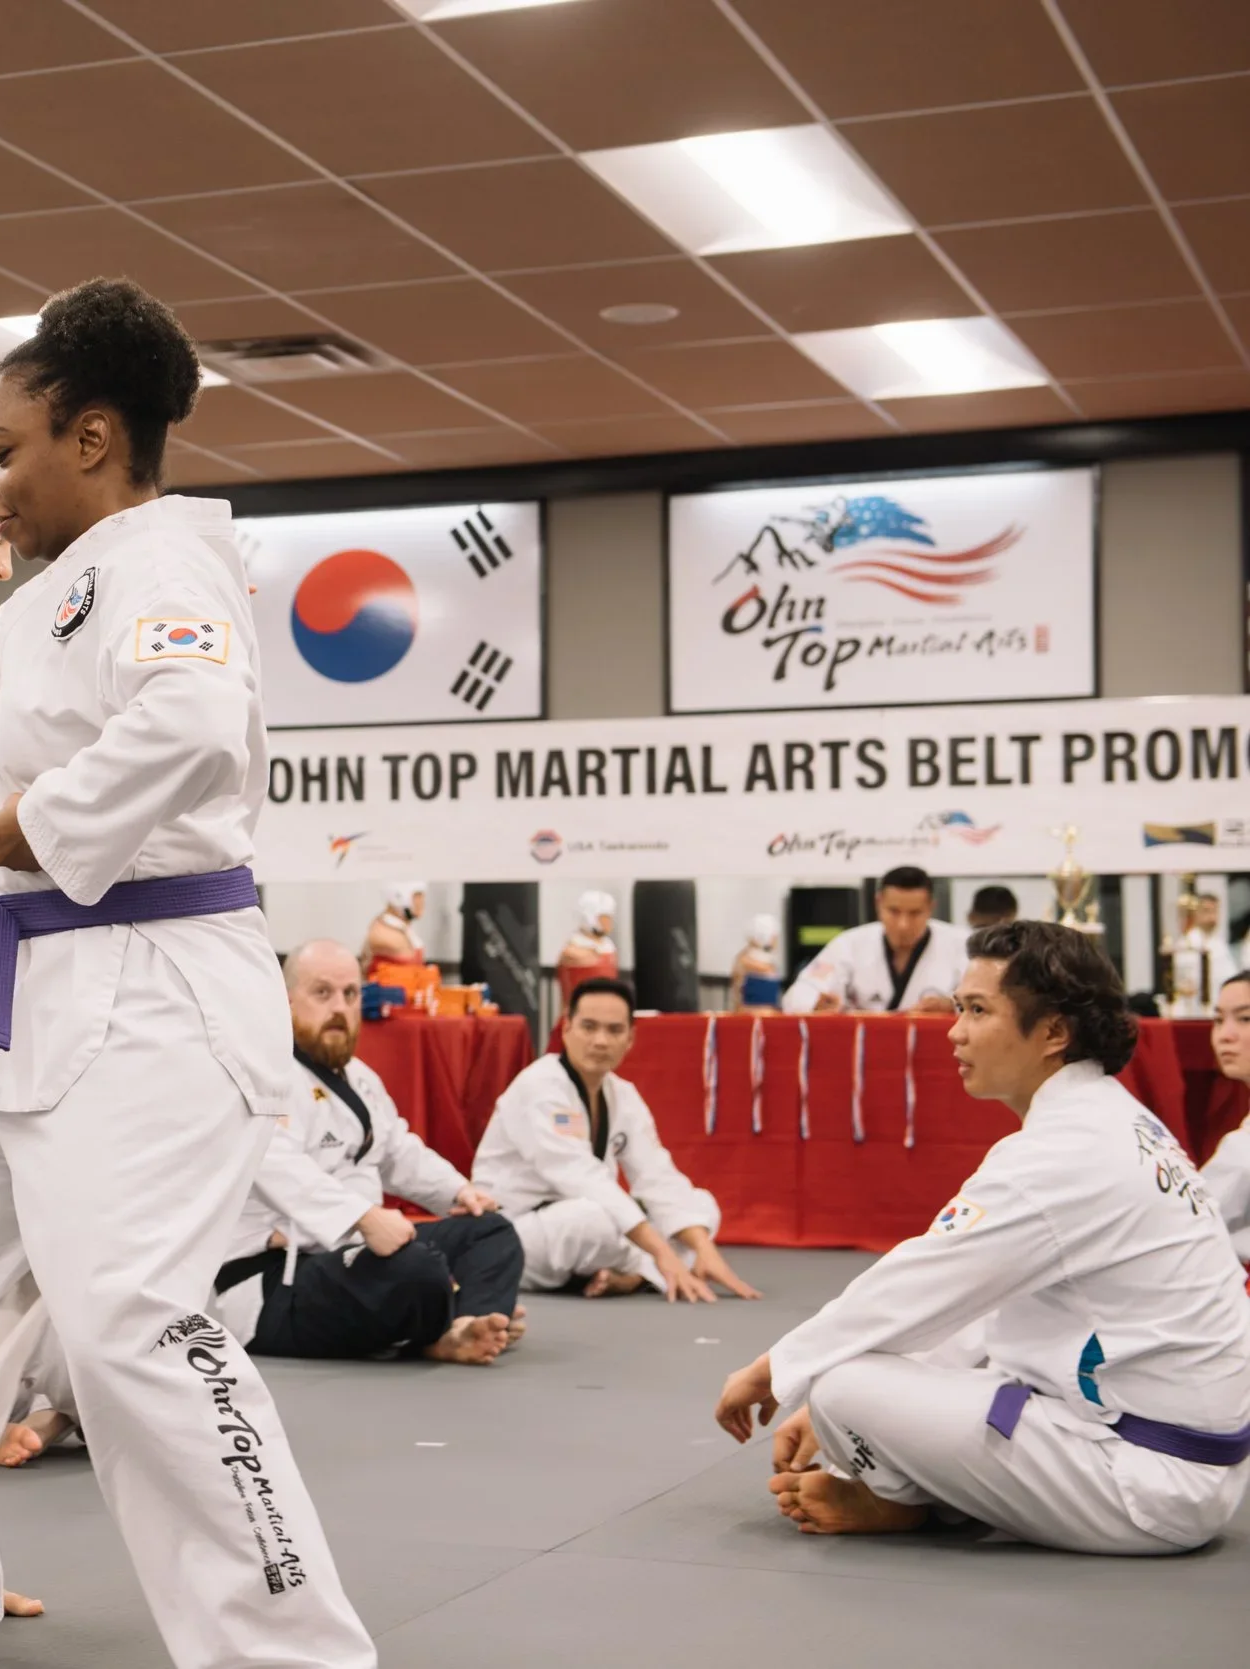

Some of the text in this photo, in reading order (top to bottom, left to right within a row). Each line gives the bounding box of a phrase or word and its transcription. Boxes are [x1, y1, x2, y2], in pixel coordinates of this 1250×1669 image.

[79, 595, 93, 616] ARTS
[721, 584, 825, 634] Ohn
[762, 626, 861, 691] Top
[867, 631, 967, 657] Martial
[973, 628, 1027, 658] Arts
[269, 727, 1250, 803] OHN TOP MARTIAL ARTS BELT PROM
[187, 1347, 237, 1415] Ohn
[217, 1410, 263, 1474] Top
[252, 1476, 293, 1545] Martial
[280, 1545, 307, 1588] Arts
